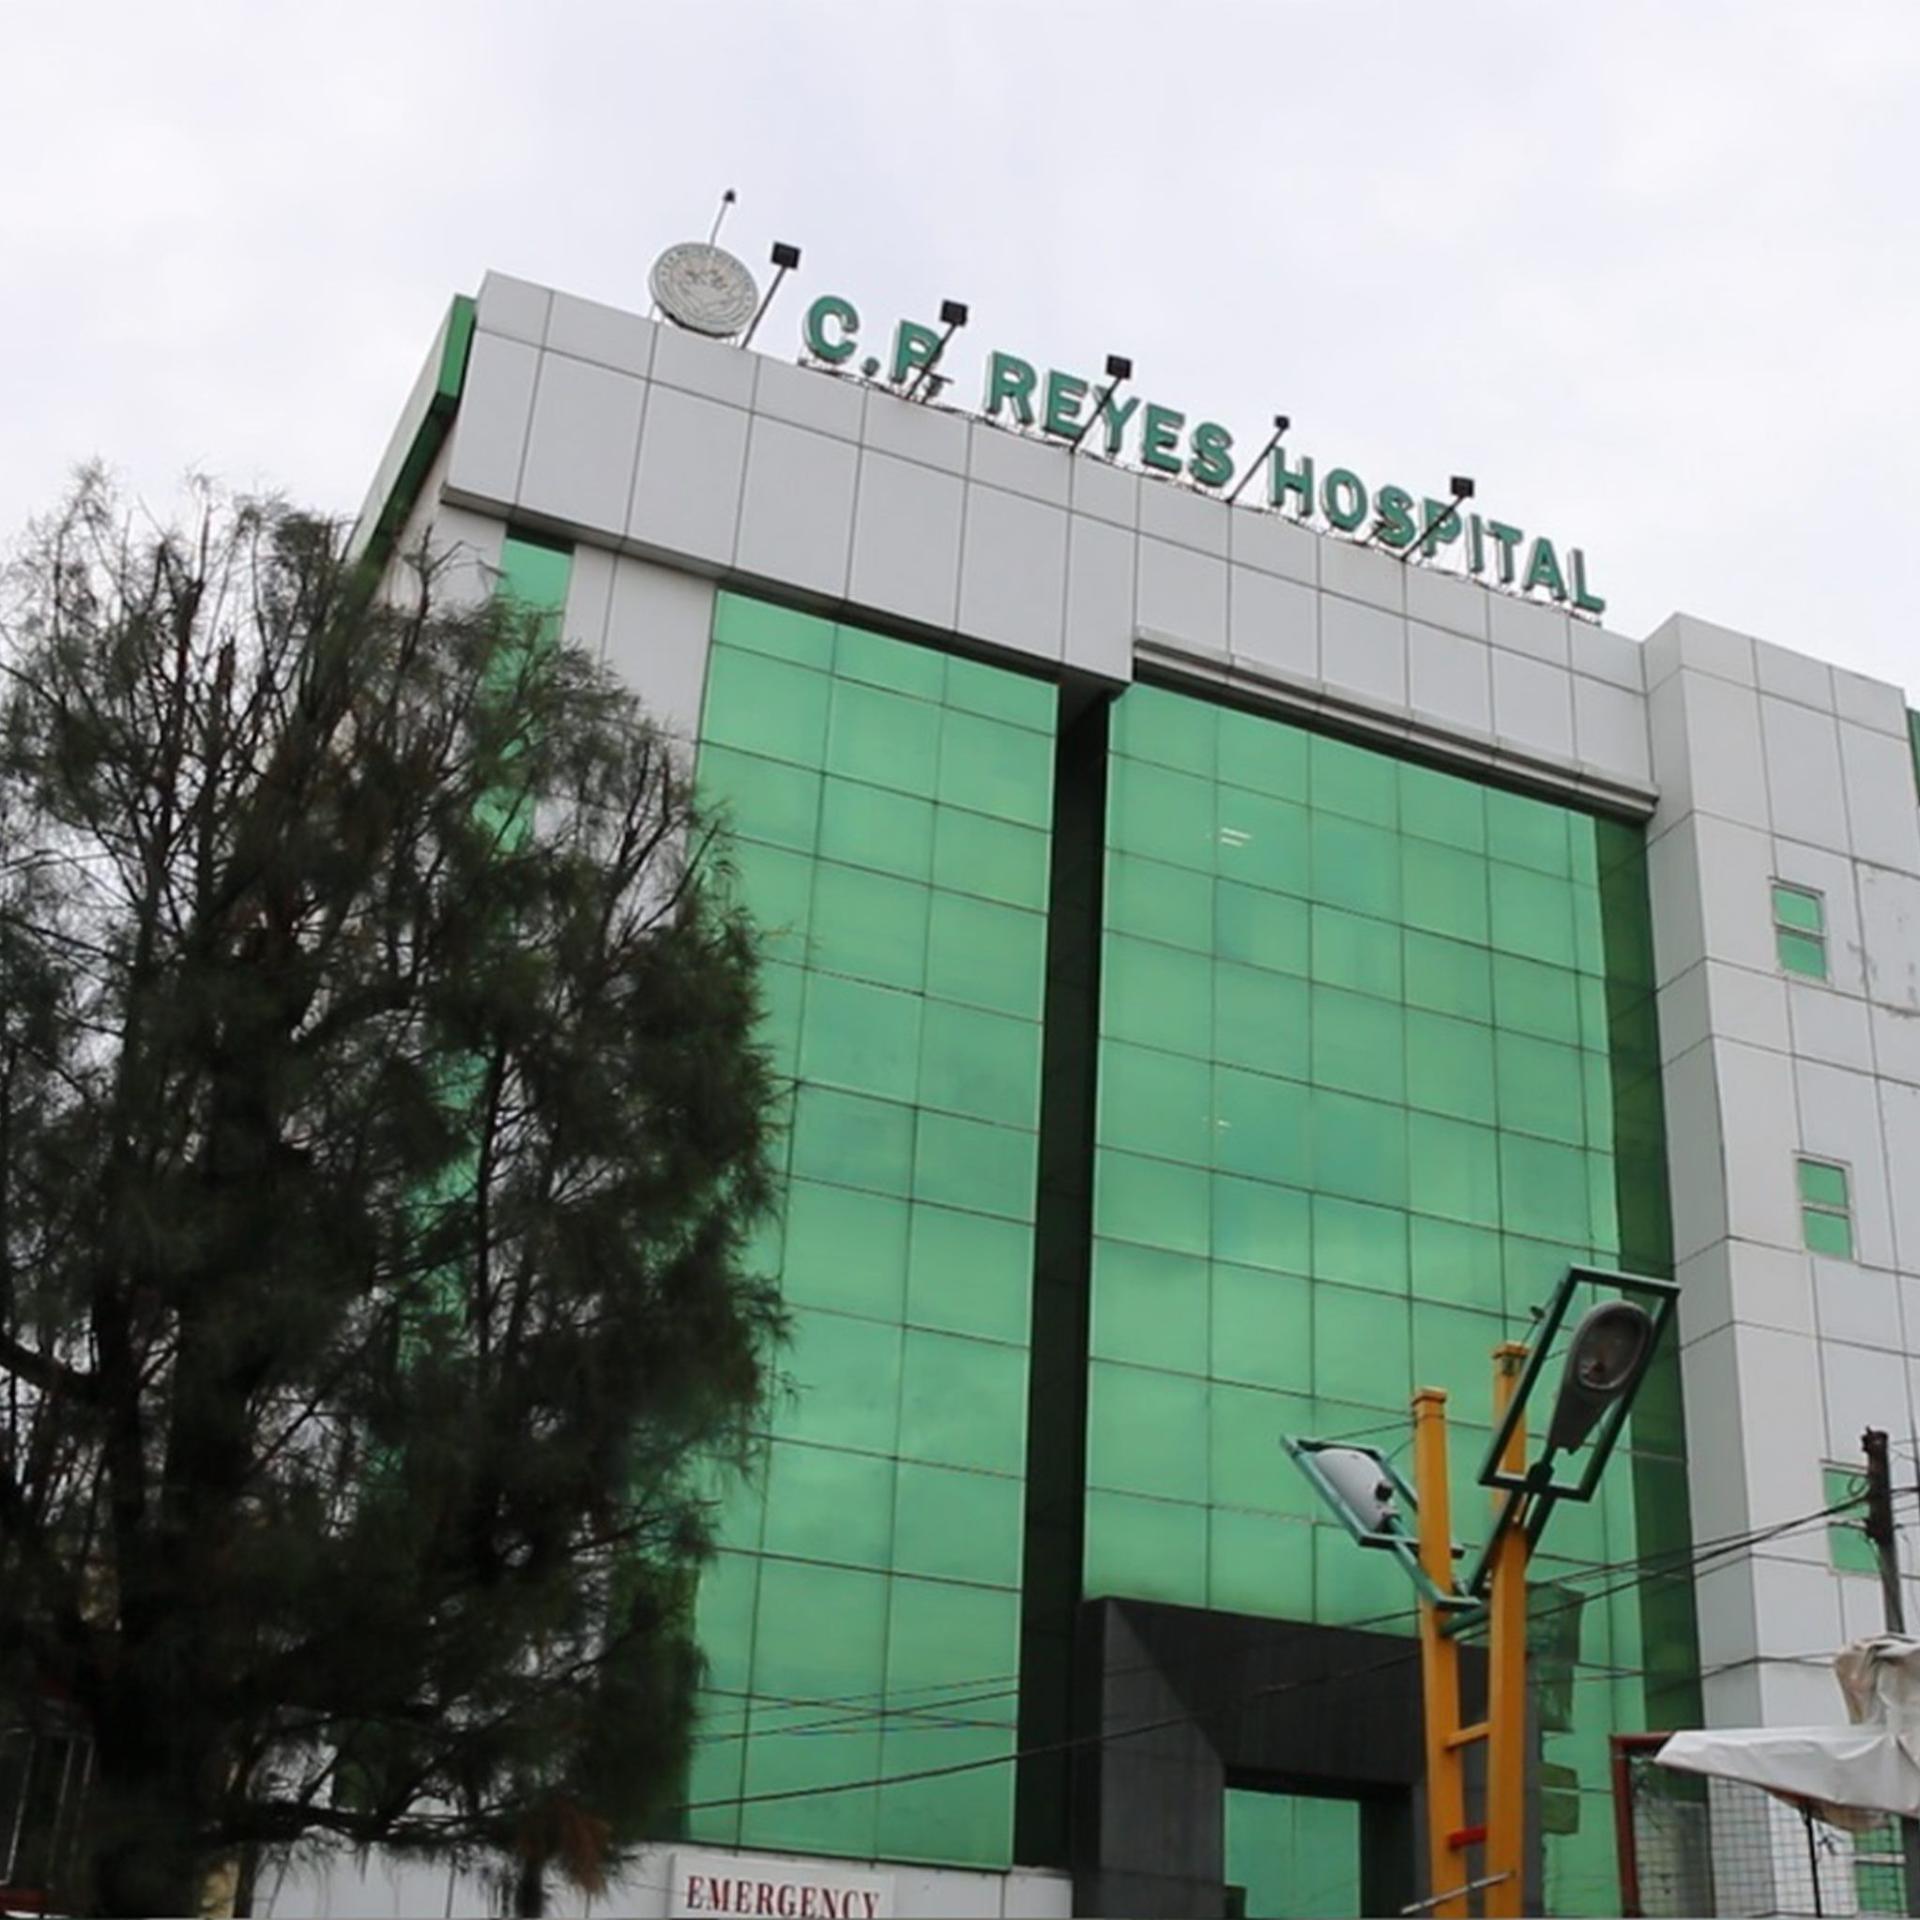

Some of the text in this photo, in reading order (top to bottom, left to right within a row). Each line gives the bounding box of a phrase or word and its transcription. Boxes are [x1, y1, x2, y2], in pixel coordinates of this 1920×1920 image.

[984, 350, 1235, 488] REYES
[1268, 446, 1606, 614] HOSPITAL
[686, 1875, 881, 1919] EMERGENCY
